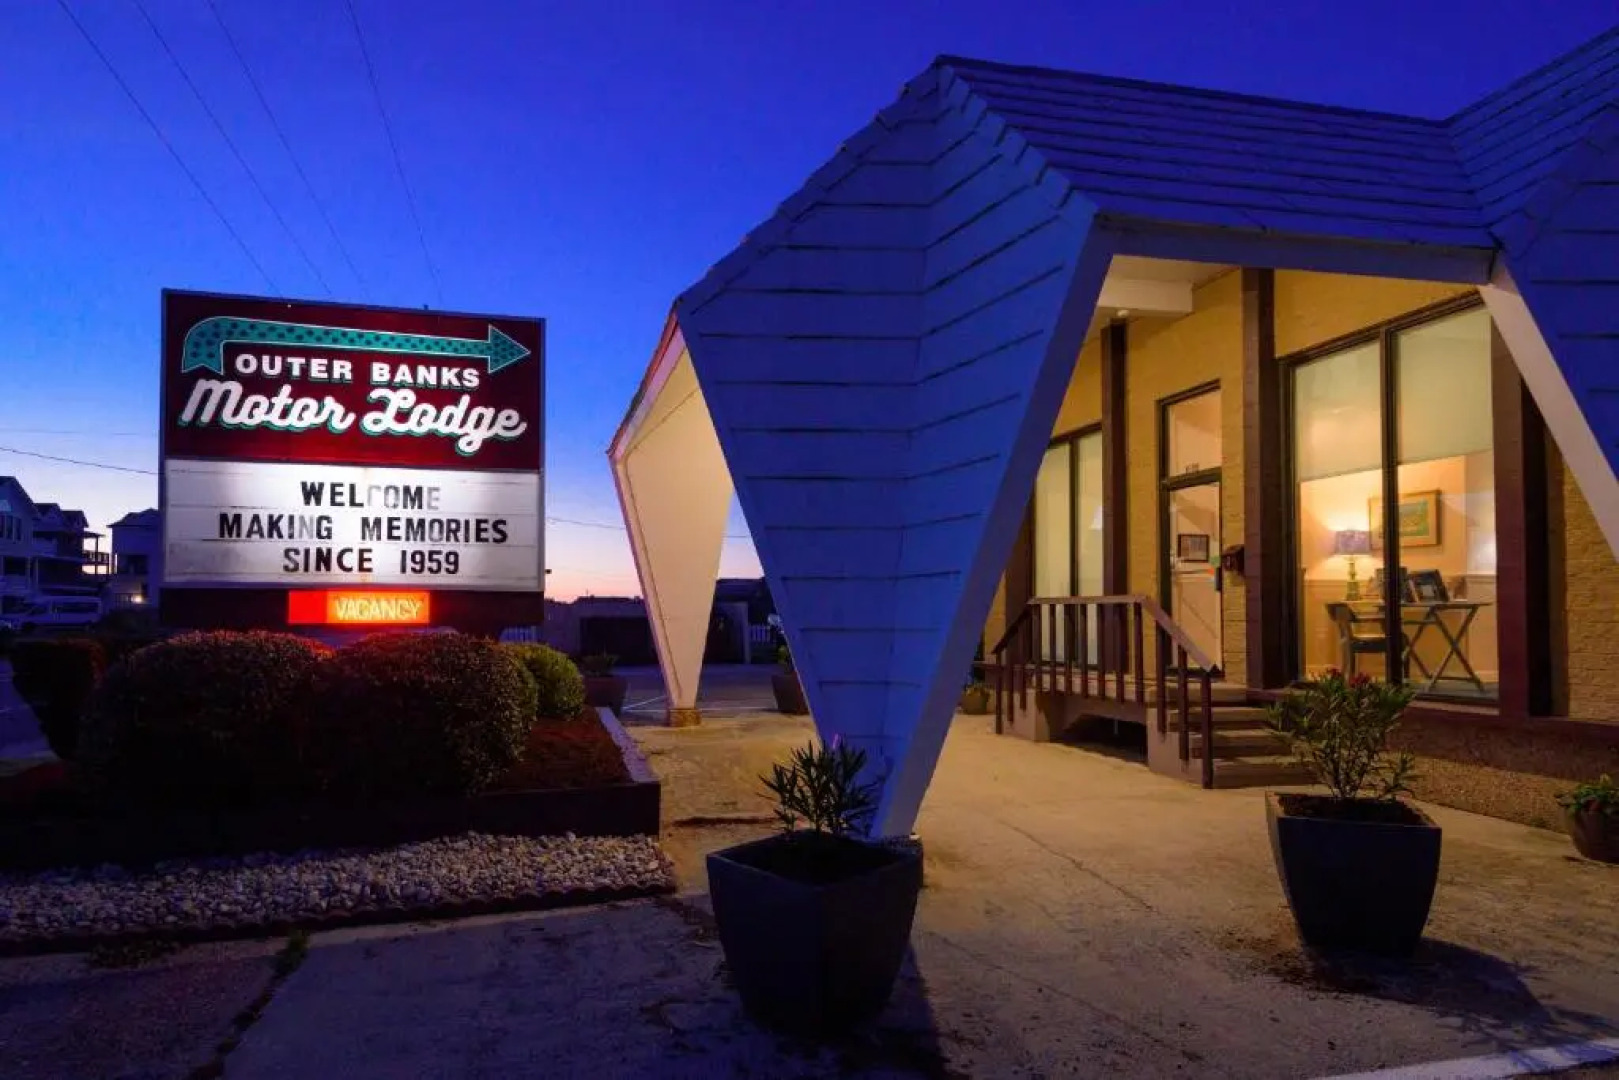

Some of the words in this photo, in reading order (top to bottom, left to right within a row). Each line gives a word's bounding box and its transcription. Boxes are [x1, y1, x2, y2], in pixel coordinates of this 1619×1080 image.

[235, 353, 353, 381] OUTER
[370, 361, 481, 389] BANKS
[179, 377, 356, 433] Motor
[360, 387, 527, 455] Lodge
[300, 480, 441, 510] WELCOME
[218, 513, 333, 541] MAKING
[361, 517, 508, 544] MEMORIES
[282, 547, 373, 573] SINCE
[400, 549, 460, 575] 1959
[335, 596, 424, 621] VACANCY
